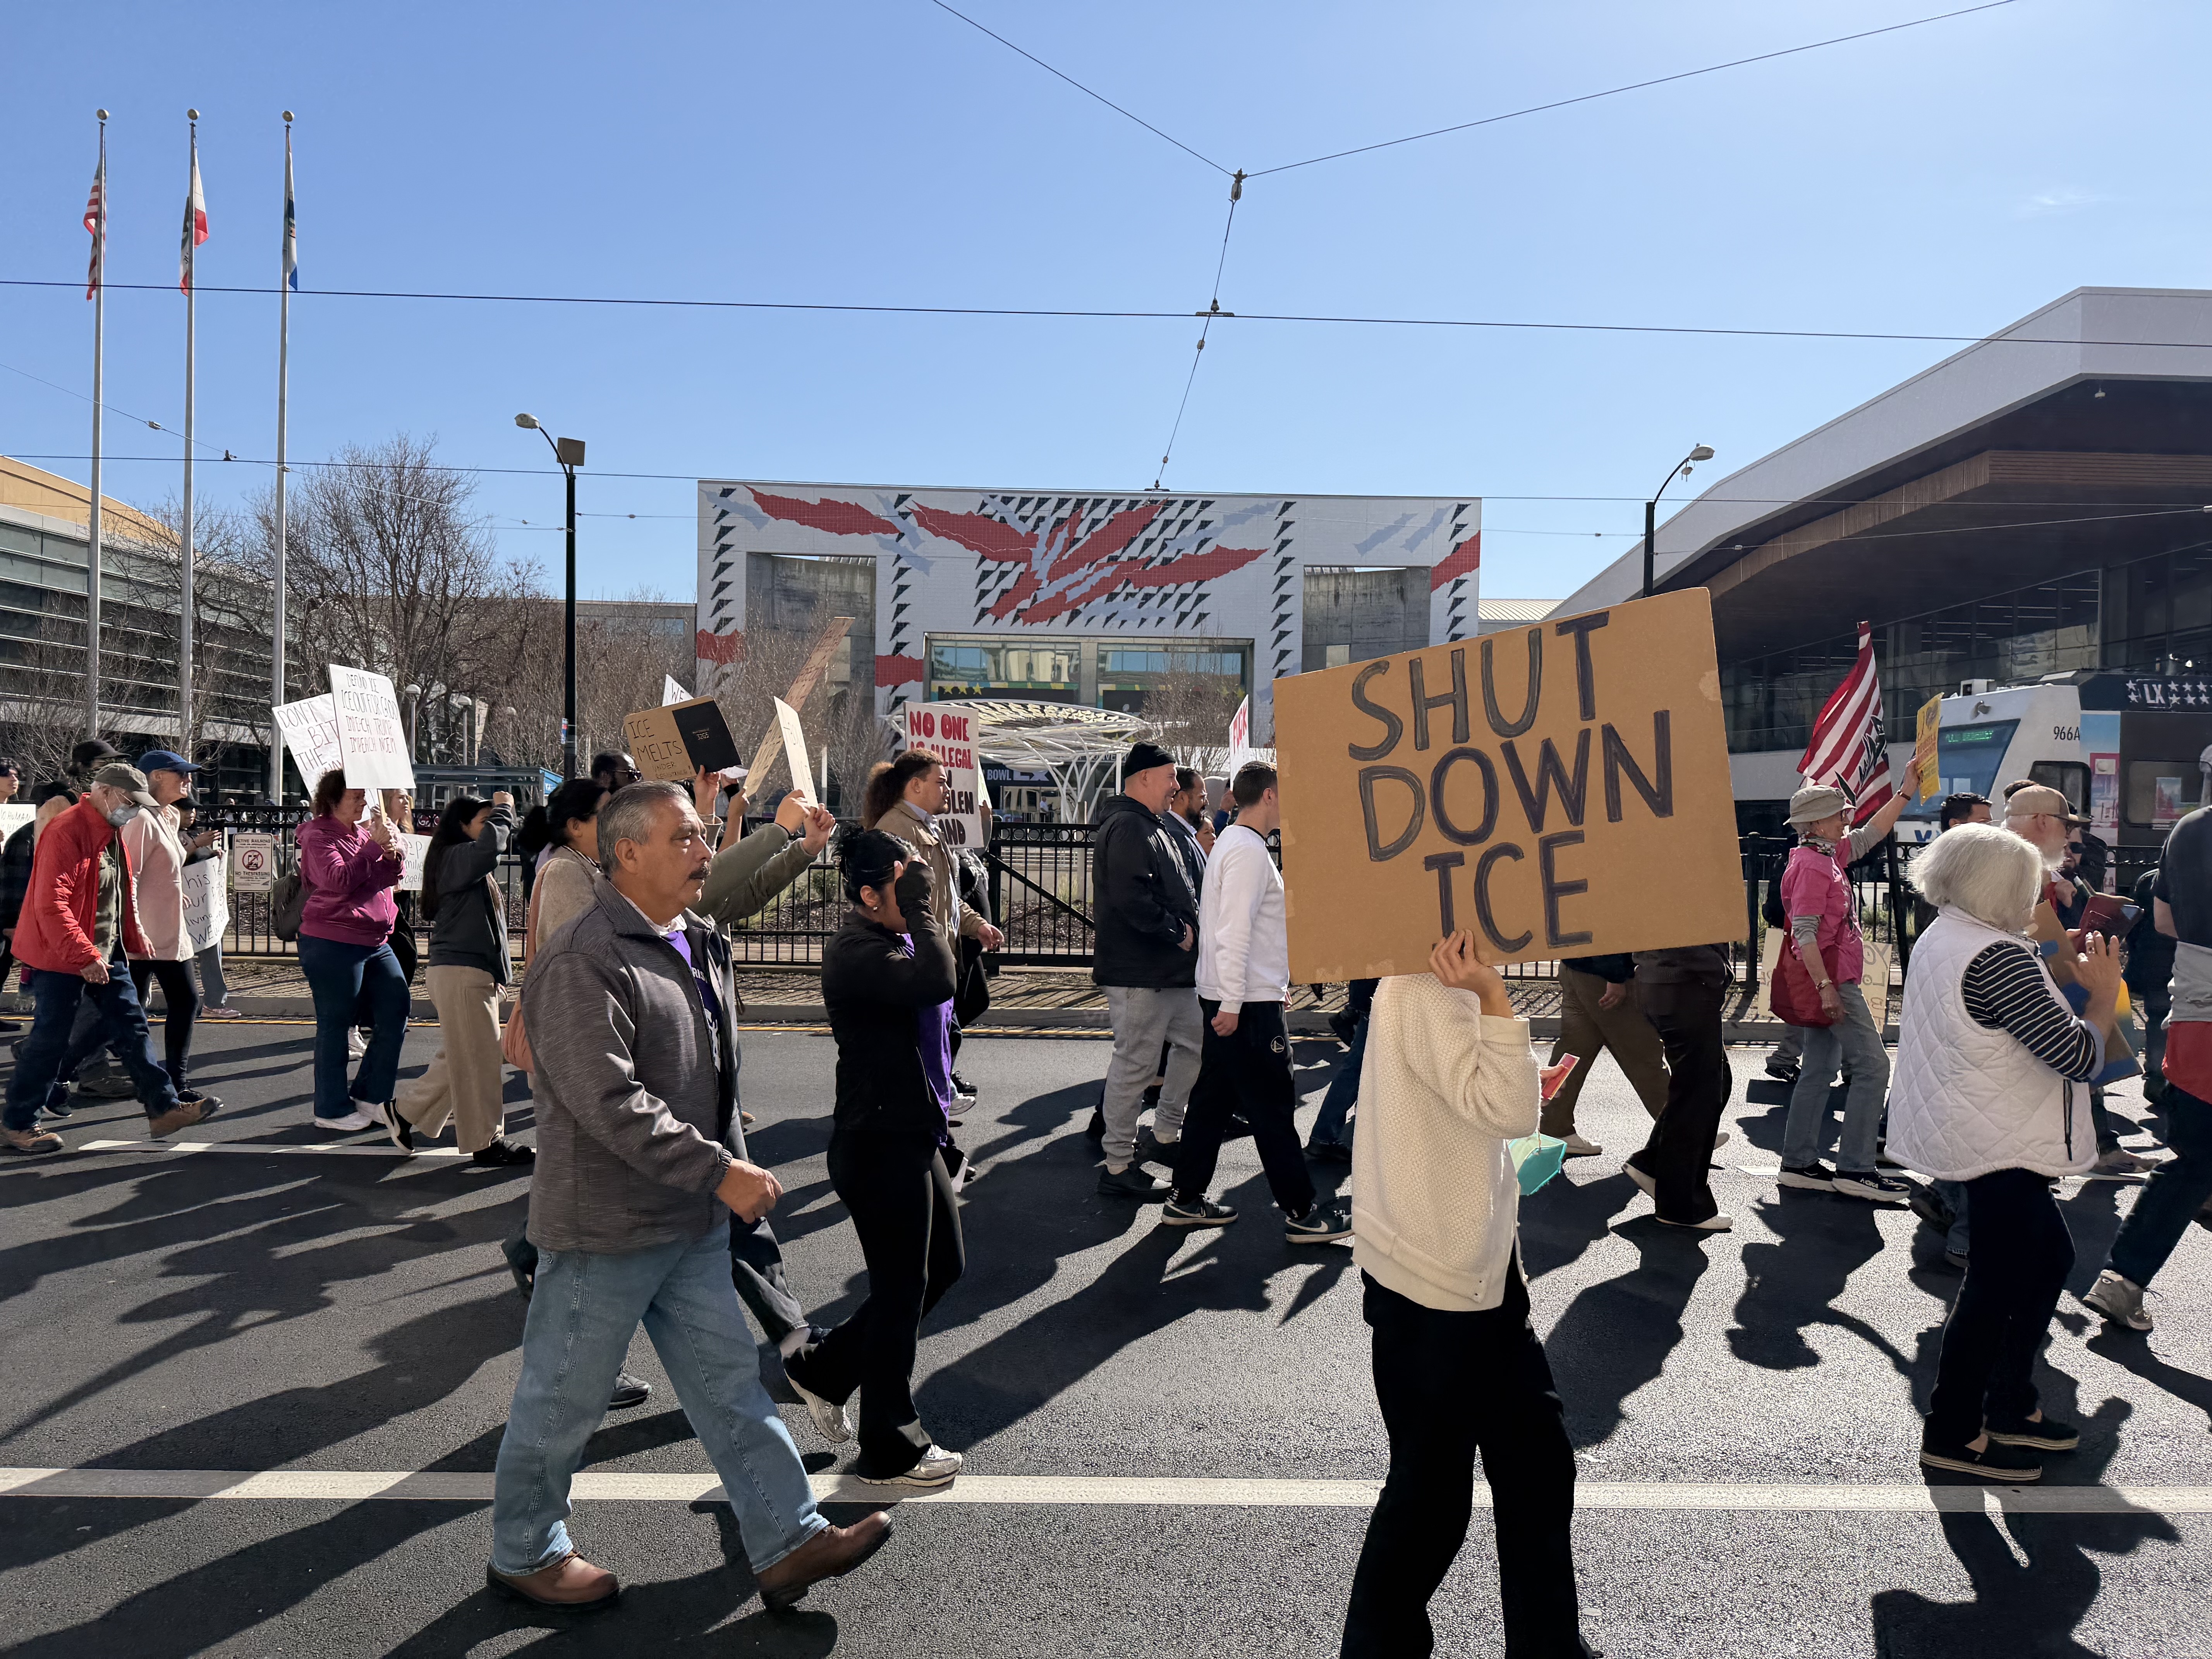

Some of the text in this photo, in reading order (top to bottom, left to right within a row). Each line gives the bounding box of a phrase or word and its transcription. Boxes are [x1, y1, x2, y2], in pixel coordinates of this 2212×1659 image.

[1348, 611, 1609, 761] SHUT
[2143, 684, 2166, 704] LX
[308, 720, 340, 747] BIT
[628, 718, 655, 739] ICE
[910, 711, 970, 742] NO ONE
[2053, 726, 2080, 741] 966A
[295, 747, 327, 771] THE
[637, 740, 682, 762] MELTS
[987, 769, 1012, 781] BOWL
[1358, 709, 1674, 862] DOWN
[945, 789, 974, 814] LEN
[939, 818, 966, 845] AND
[405, 859, 423, 872] milie
[184, 874, 210, 889] his
[1424, 830, 1593, 953] ICE
